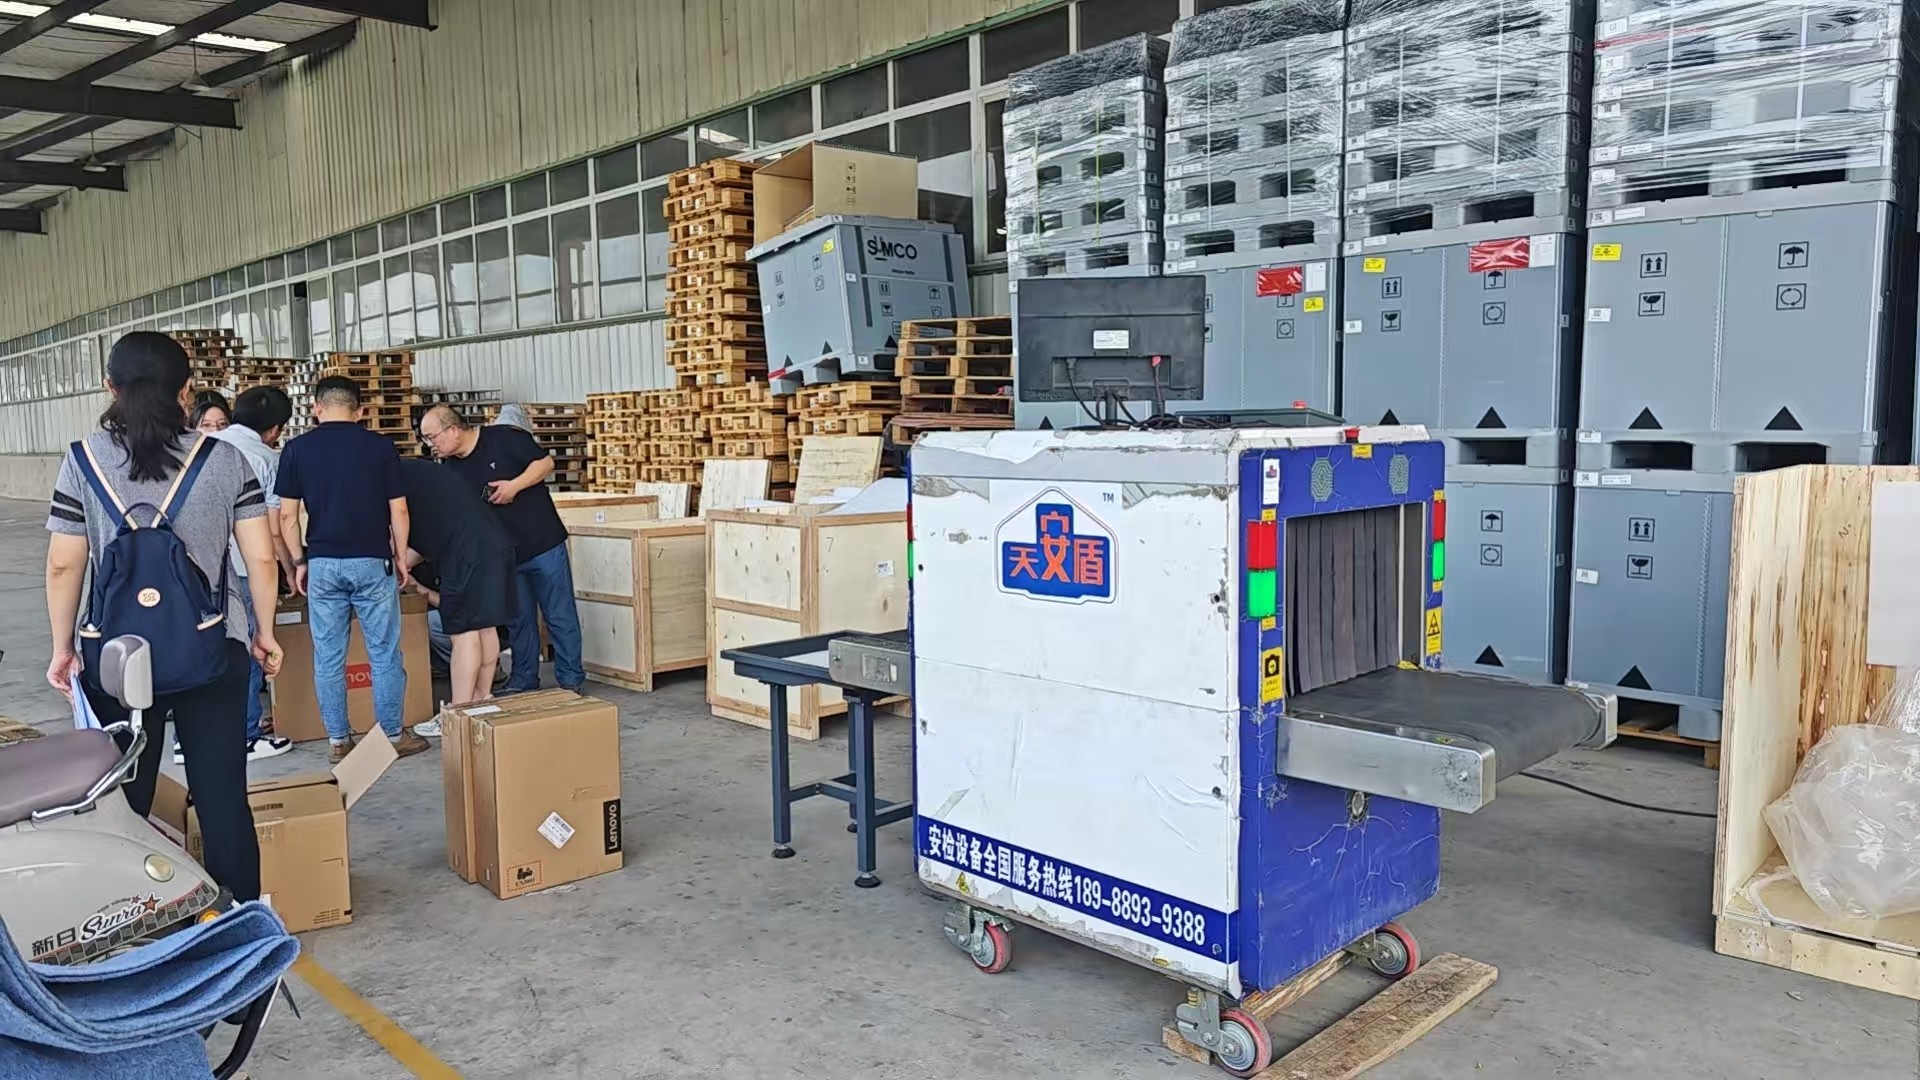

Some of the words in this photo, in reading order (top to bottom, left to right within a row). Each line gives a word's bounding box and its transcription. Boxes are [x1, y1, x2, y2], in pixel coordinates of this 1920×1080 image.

[1102, 492, 1115, 503] TM
[1009, 511, 1104, 586] 天安盾
[608, 803, 619, 851] Lenovo
[32, 926, 76, 956] 新日
[81, 904, 142, 941] Sunra
